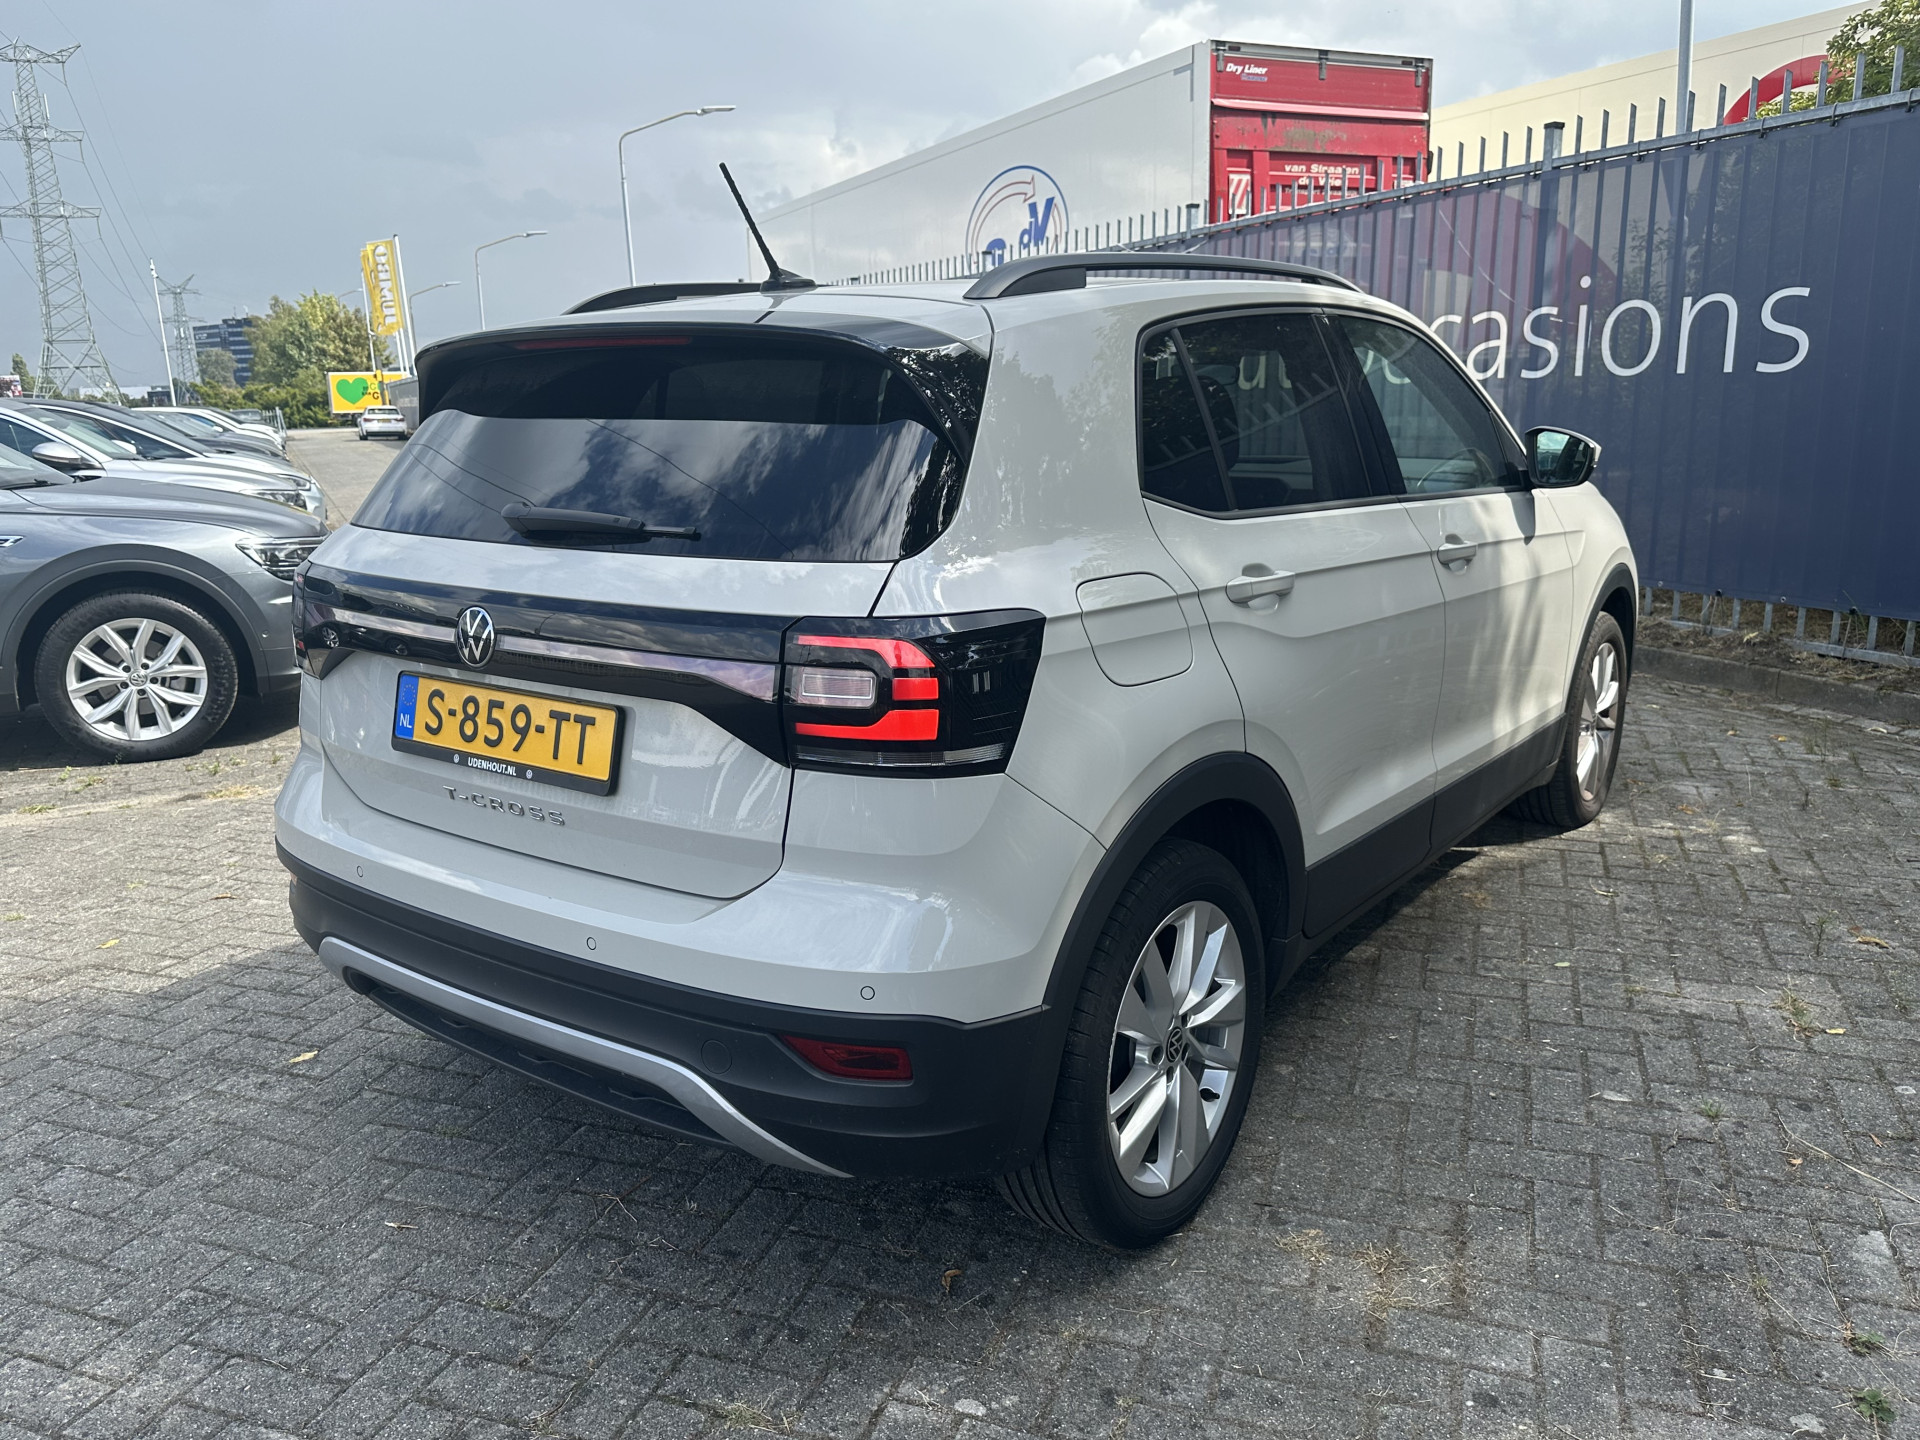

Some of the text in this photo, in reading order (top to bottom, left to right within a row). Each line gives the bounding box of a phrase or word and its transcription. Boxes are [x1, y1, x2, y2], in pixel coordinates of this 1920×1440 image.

[1226, 63, 1243, 75] Dry
[1284, 164, 1306, 173] van
[399, 712, 412, 729] NL
[424, 688, 596, 765] S-859-TT
[467, 756, 517, 776] UDENHOUT.NL
[443, 785, 566, 826] T-CROSS
